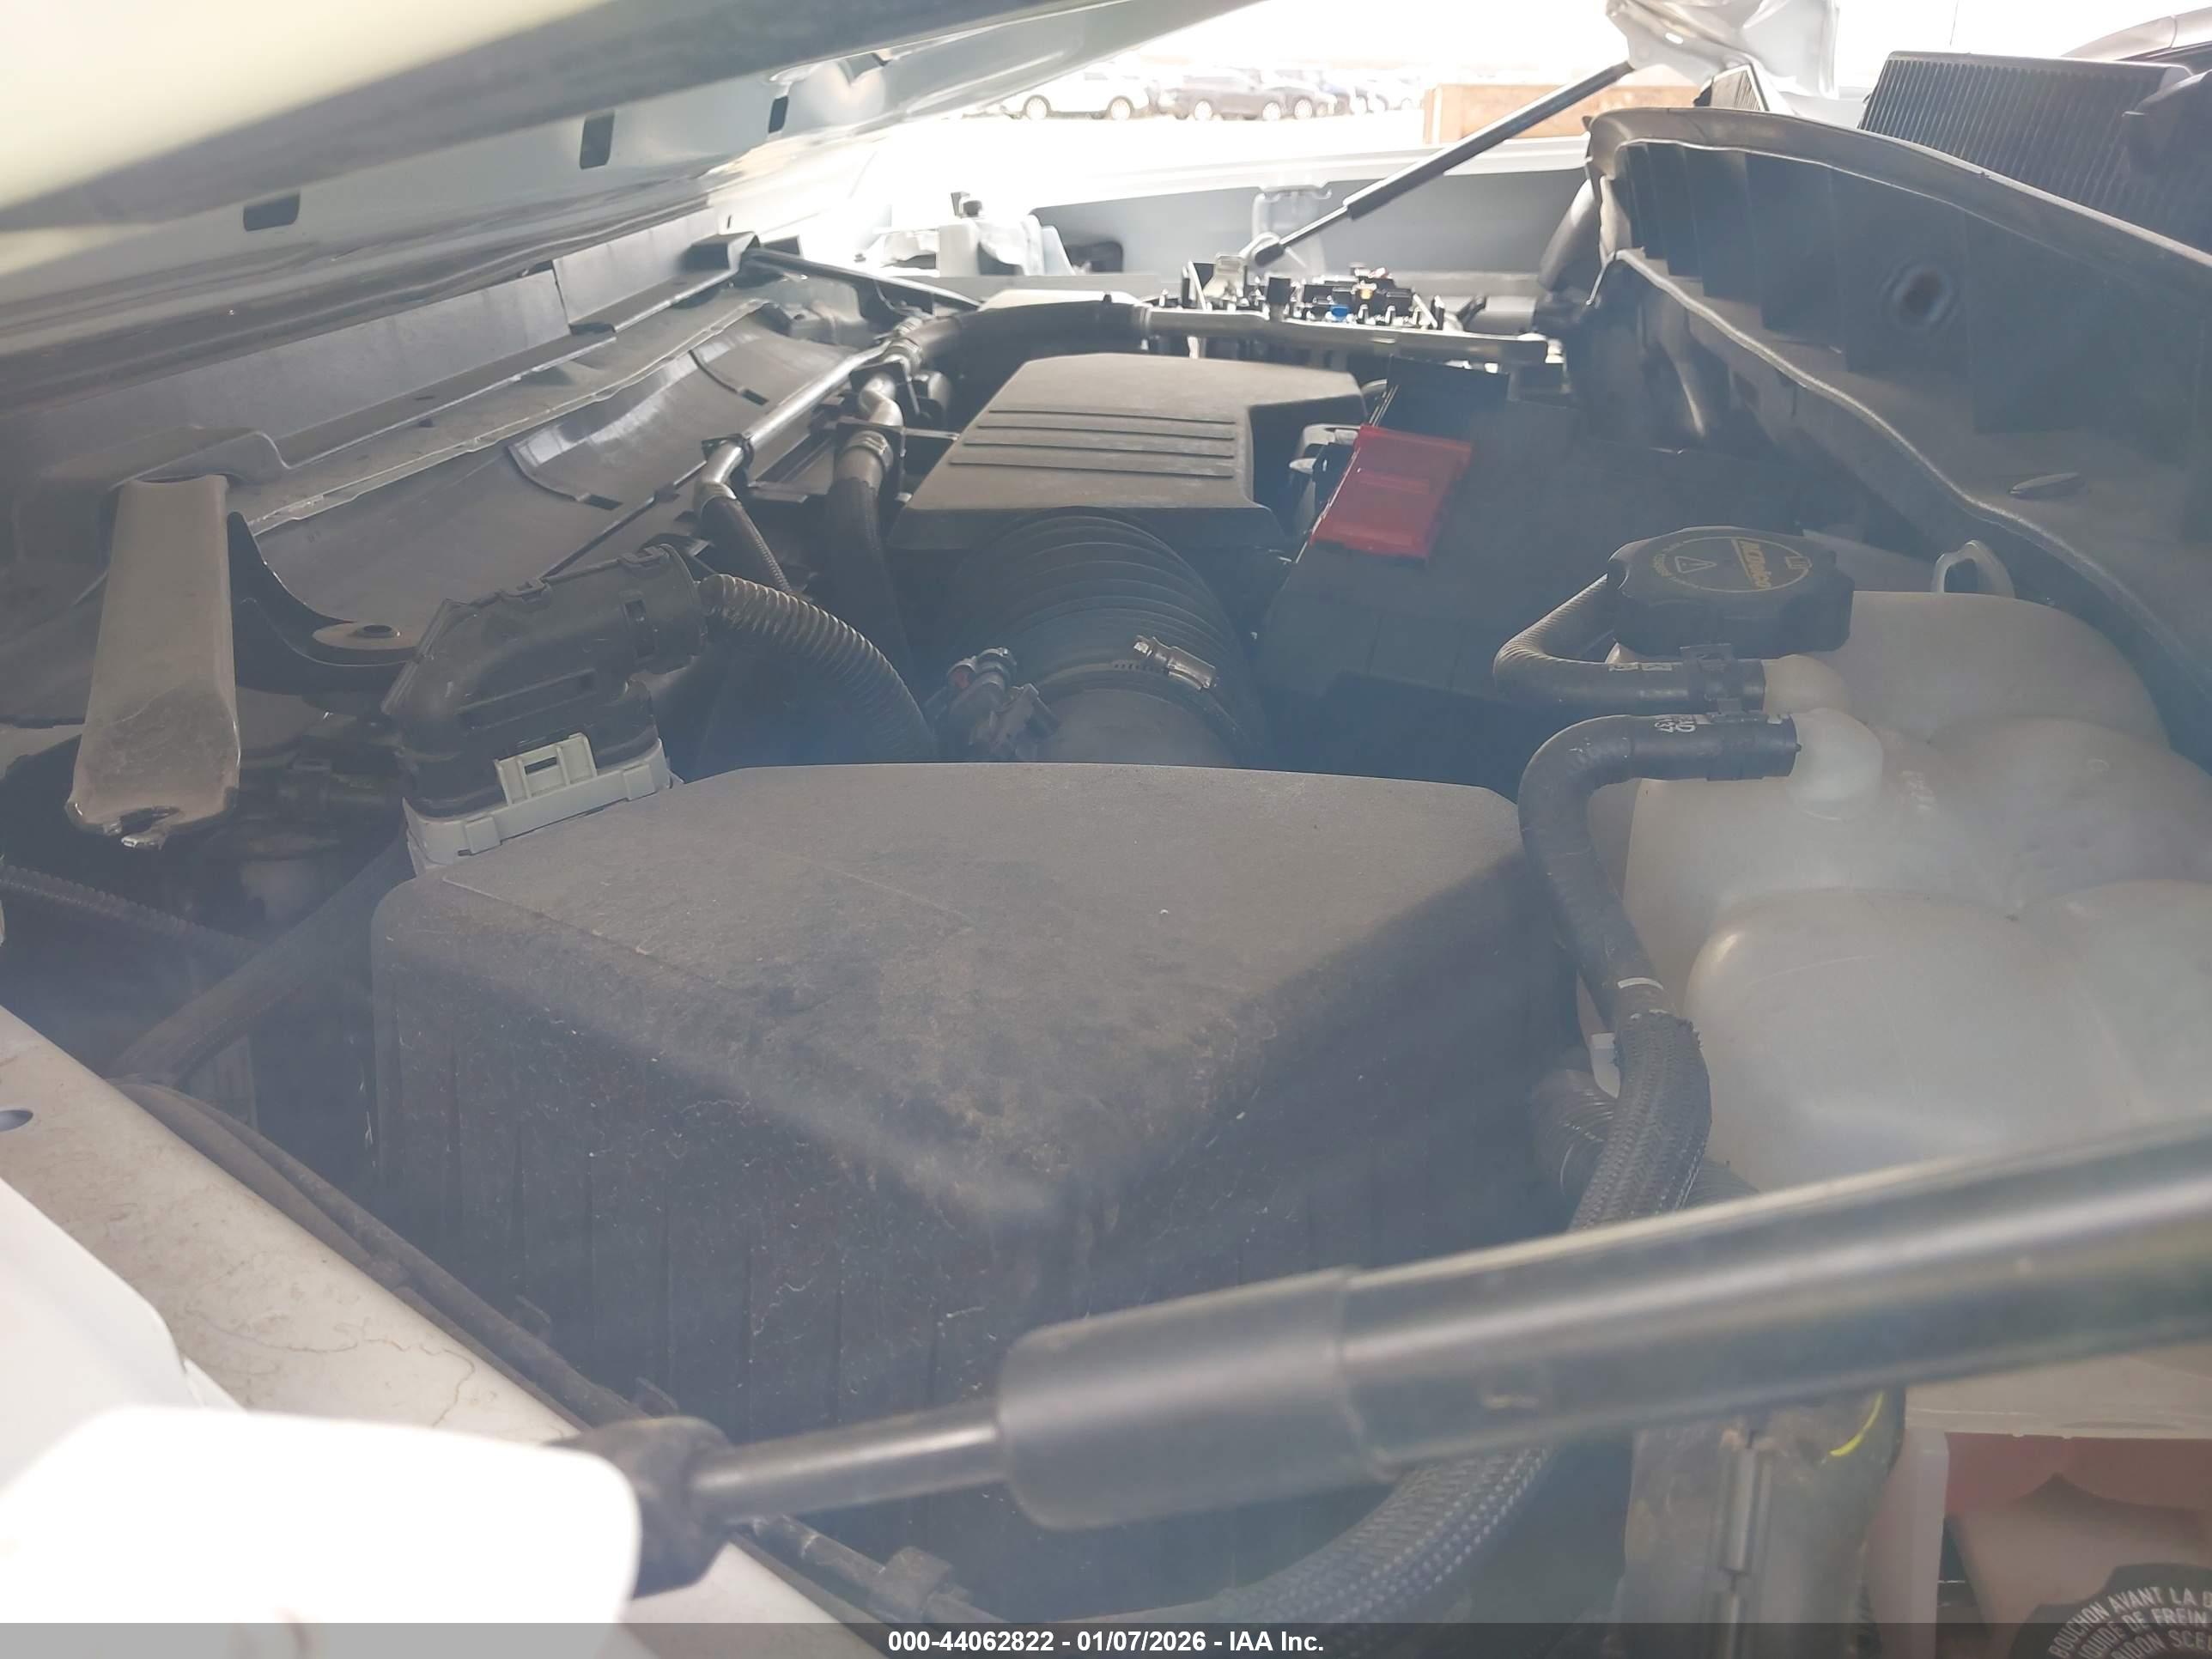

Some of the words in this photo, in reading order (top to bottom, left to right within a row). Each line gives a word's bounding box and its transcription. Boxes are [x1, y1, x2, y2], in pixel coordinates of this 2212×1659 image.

[2048, 1601, 2111, 1658] BOUCHON
[2107, 1587, 2164, 1613] AVANT
[2169, 1587, 2198, 1606] LA
[2121, 1611, 2150, 1632] DE
[2151, 1607, 2208, 1627] FREIN
